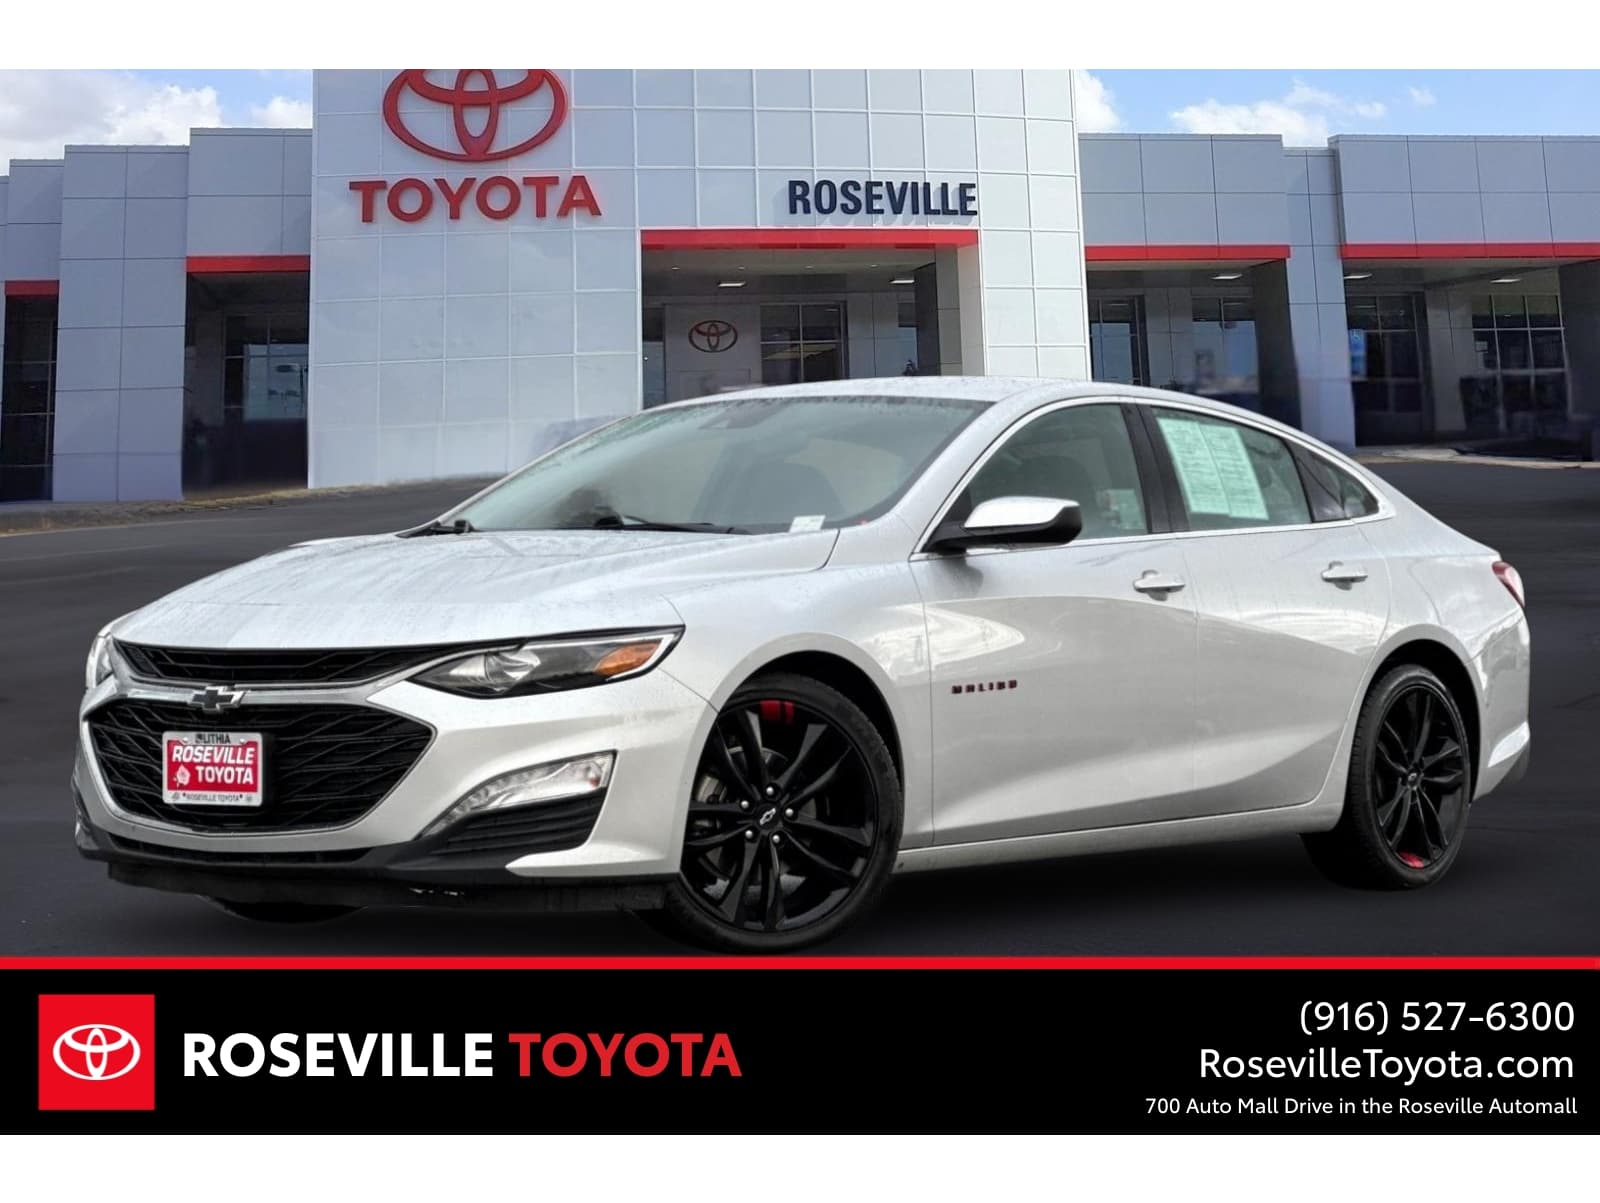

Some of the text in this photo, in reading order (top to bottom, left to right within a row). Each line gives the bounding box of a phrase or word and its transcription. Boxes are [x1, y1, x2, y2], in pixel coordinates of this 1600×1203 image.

[349, 175, 602, 223] TOYOTA
[788, 180, 978, 216] ROSEVILLE
[172, 745, 255, 764] ROSEVILLE
[195, 766, 254, 784] TOYOTA
[186, 793, 239, 802] ROSEVILLE TOYOTA
